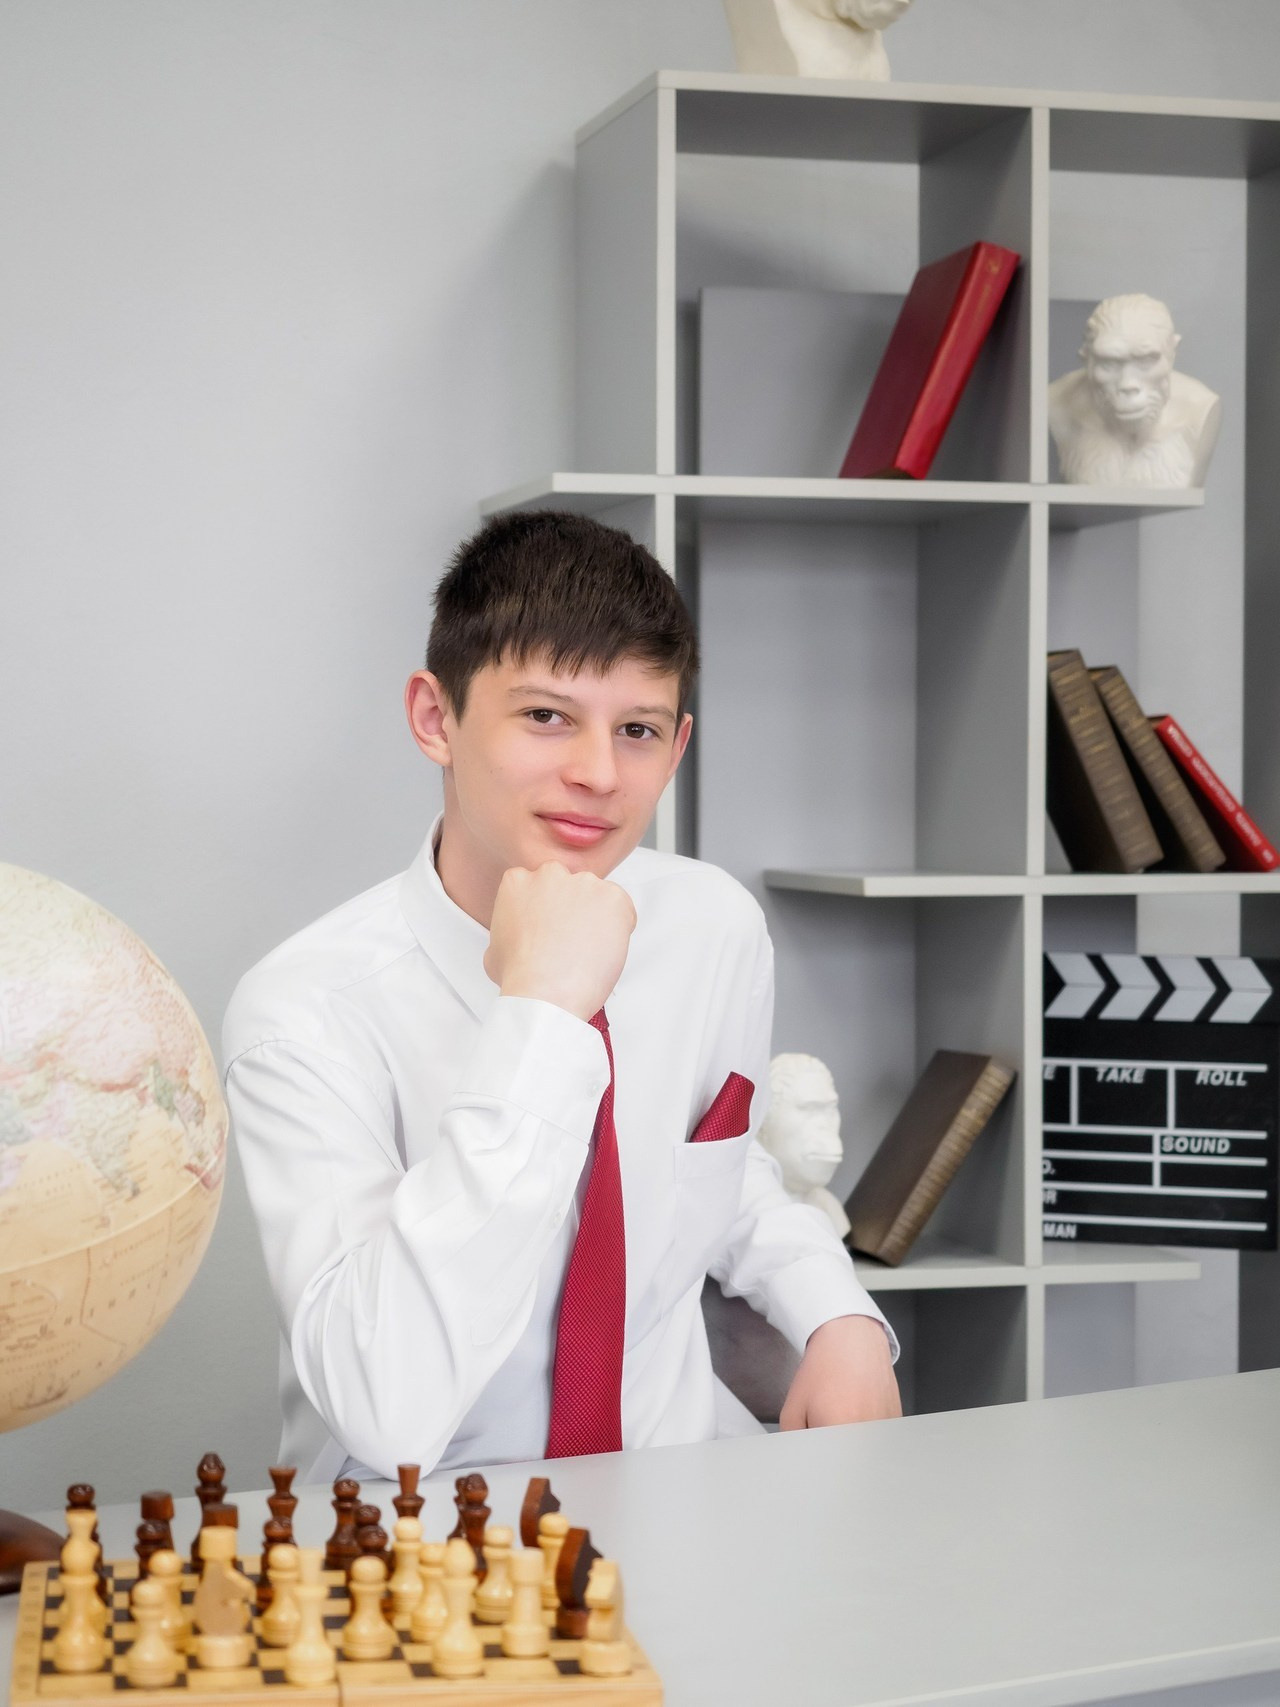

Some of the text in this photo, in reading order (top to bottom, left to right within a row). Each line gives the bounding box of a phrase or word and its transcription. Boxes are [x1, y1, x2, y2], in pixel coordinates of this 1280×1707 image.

[1096, 1066, 1145, 1083] TAKE
[1195, 1069, 1247, 1087] ROLL
[1161, 1136, 1231, 1154] SOUND
